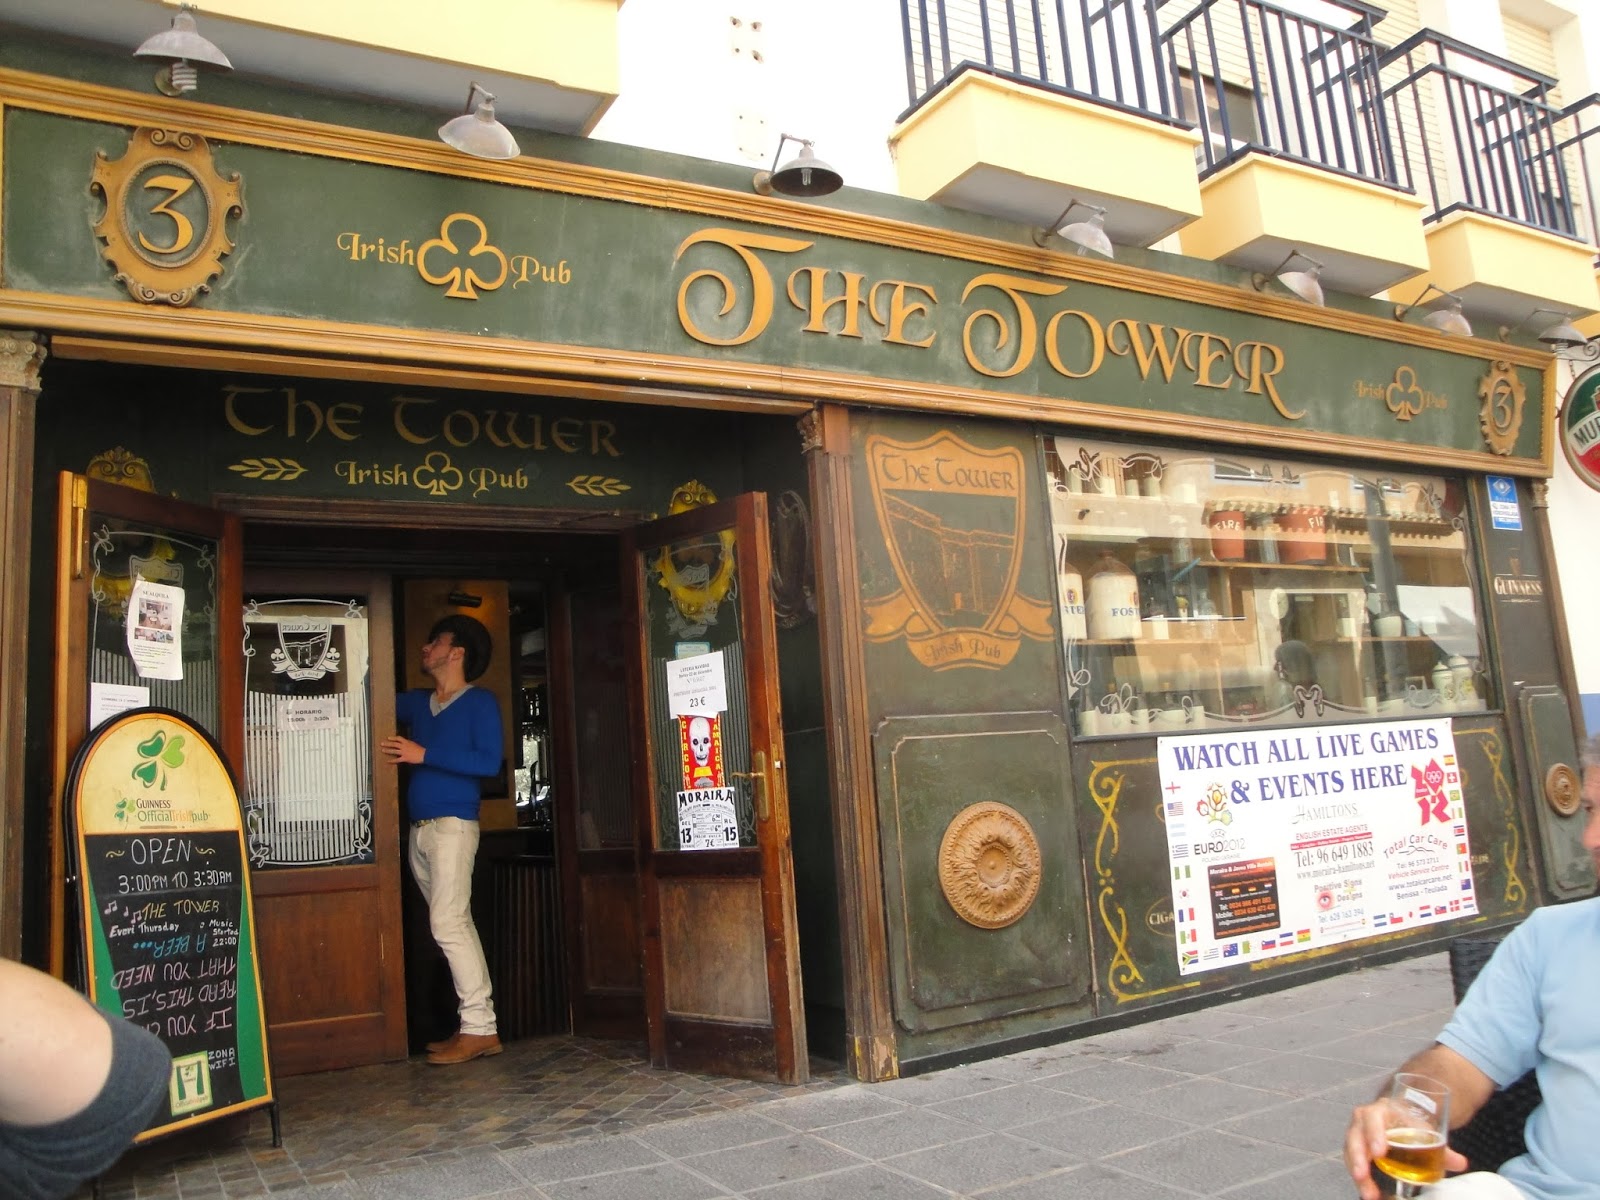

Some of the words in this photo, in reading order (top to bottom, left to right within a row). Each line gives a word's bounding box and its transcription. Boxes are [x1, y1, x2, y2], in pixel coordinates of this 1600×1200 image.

[138, 175, 194, 254] 3
[337, 232, 414, 266] Irish
[510, 255, 571, 289] Pub
[674, 228, 938, 348] THE
[960, 273, 1307, 420] TOWER
[220, 384, 364, 443] The
[1492, 385, 1513, 428] 3
[335, 461, 408, 486] Irish
[468, 467, 528, 498] Pub
[881, 453, 930, 484] The
[1214, 519, 1242, 532] FIRE
[1494, 577, 1542, 595] GUINNESS
[924, 638, 963, 660] Irish
[969, 638, 1000, 658] Pub
[690, 698, 698, 707] 23
[701, 696, 705, 705] €
[682, 721, 690, 773] CIRCO
[1173, 741, 1259, 770] WATCH
[1267, 738, 1309, 763] ALL
[1316, 734, 1364, 758] LIVE
[1370, 728, 1438, 753] GAMES
[1231, 780, 1250, 804] &
[1258, 770, 1344, 801] EVENTS
[1350, 764, 1407, 790] HERE
[136, 799, 171, 809] GUINNESS
[679, 790, 733, 808] MORAIRA
[1292, 802, 1358, 824] HAMILTONS
[681, 828, 691, 843] 13
[723, 827, 736, 841] 15
[1296, 831, 1321, 840] ENGLISH
[1322, 827, 1344, 837] ESTATE
[1346, 824, 1368, 832] AGENTS
[131, 838, 191, 864] OPEN
[1295, 850, 1314, 867] Tel:
[1317, 848, 1328, 863] 96
[1332, 845, 1348, 861] 649
[1352, 841, 1373, 858] 1883
[1384, 837, 1406, 858] Total
[1410, 835, 1424, 843] Car
[1428, 835, 1447, 849] Care
[118, 874, 167, 894] 3:00PM
[171, 872, 188, 889] TO
[194, 870, 232, 887] 3:30AM
[1410, 868, 1430, 876] Service
[1314, 882, 1341, 893] Positive
[1344, 879, 1362, 888] Signs
[1337, 892, 1362, 901] Designs
[142, 902, 167, 920] THE
[174, 900, 219, 914] TOWER
[138, 922, 179, 932] Thursday
[209, 919, 233, 928] Music
[196, 934, 206, 953] A
[212, 938, 236, 947] 22:00
[110, 964, 155, 989] NEED
[164, 962, 190, 980] YOU
[198, 956, 236, 978] THAT
[198, 980, 236, 1002] READ
[168, 1014, 196, 1037] YOU
[204, 1007, 232, 1032] IF
[209, 1048, 235, 1060] ZONA
[209, 1057, 236, 1070] WIFI
